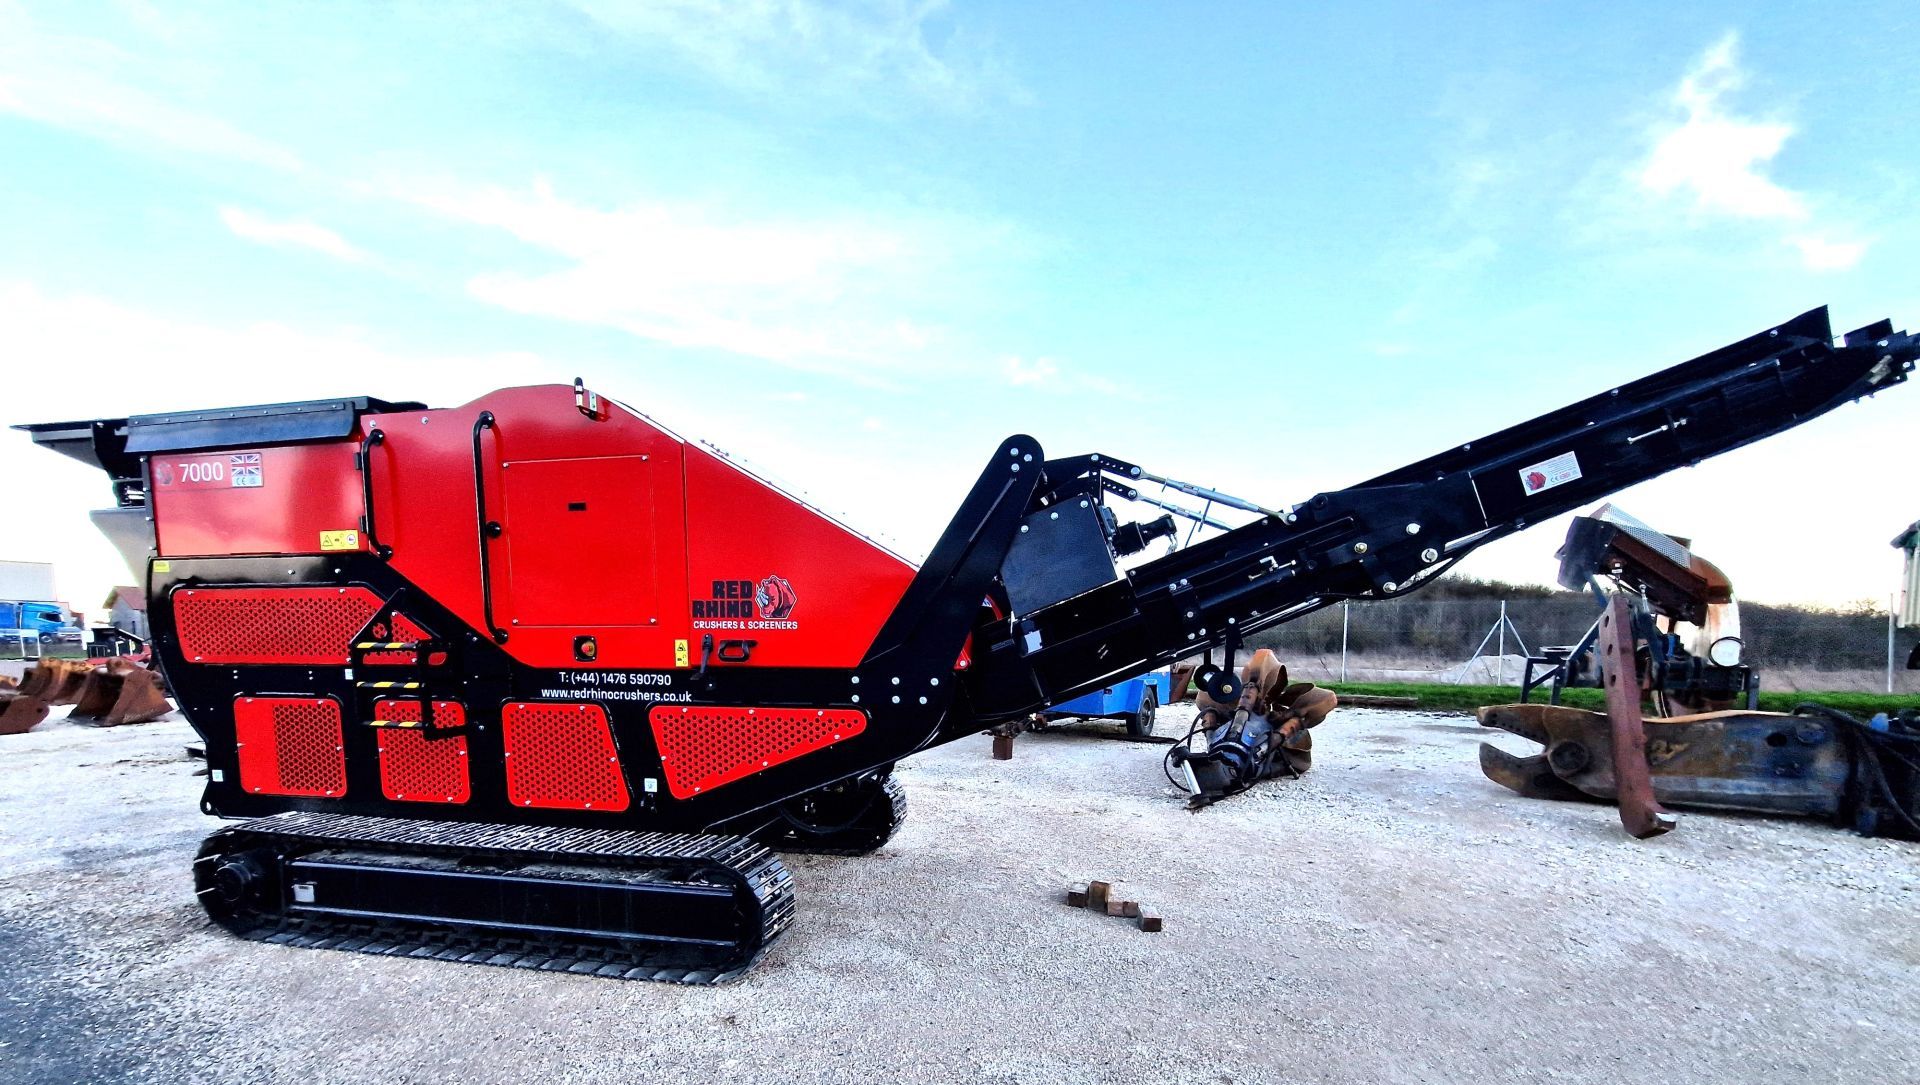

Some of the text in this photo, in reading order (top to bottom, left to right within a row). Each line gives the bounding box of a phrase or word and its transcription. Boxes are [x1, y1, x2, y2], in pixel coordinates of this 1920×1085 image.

[178, 462, 223, 482] 7000
[713, 581, 752, 598] RED
[692, 600, 752, 618] RHINO
[693, 621, 798, 629] CRUSHERS & SCREENERS
[559, 672, 671, 685] T: (+44) 1476 590790
[541, 688, 692, 702] www.redrhinocrushers.co.uk
